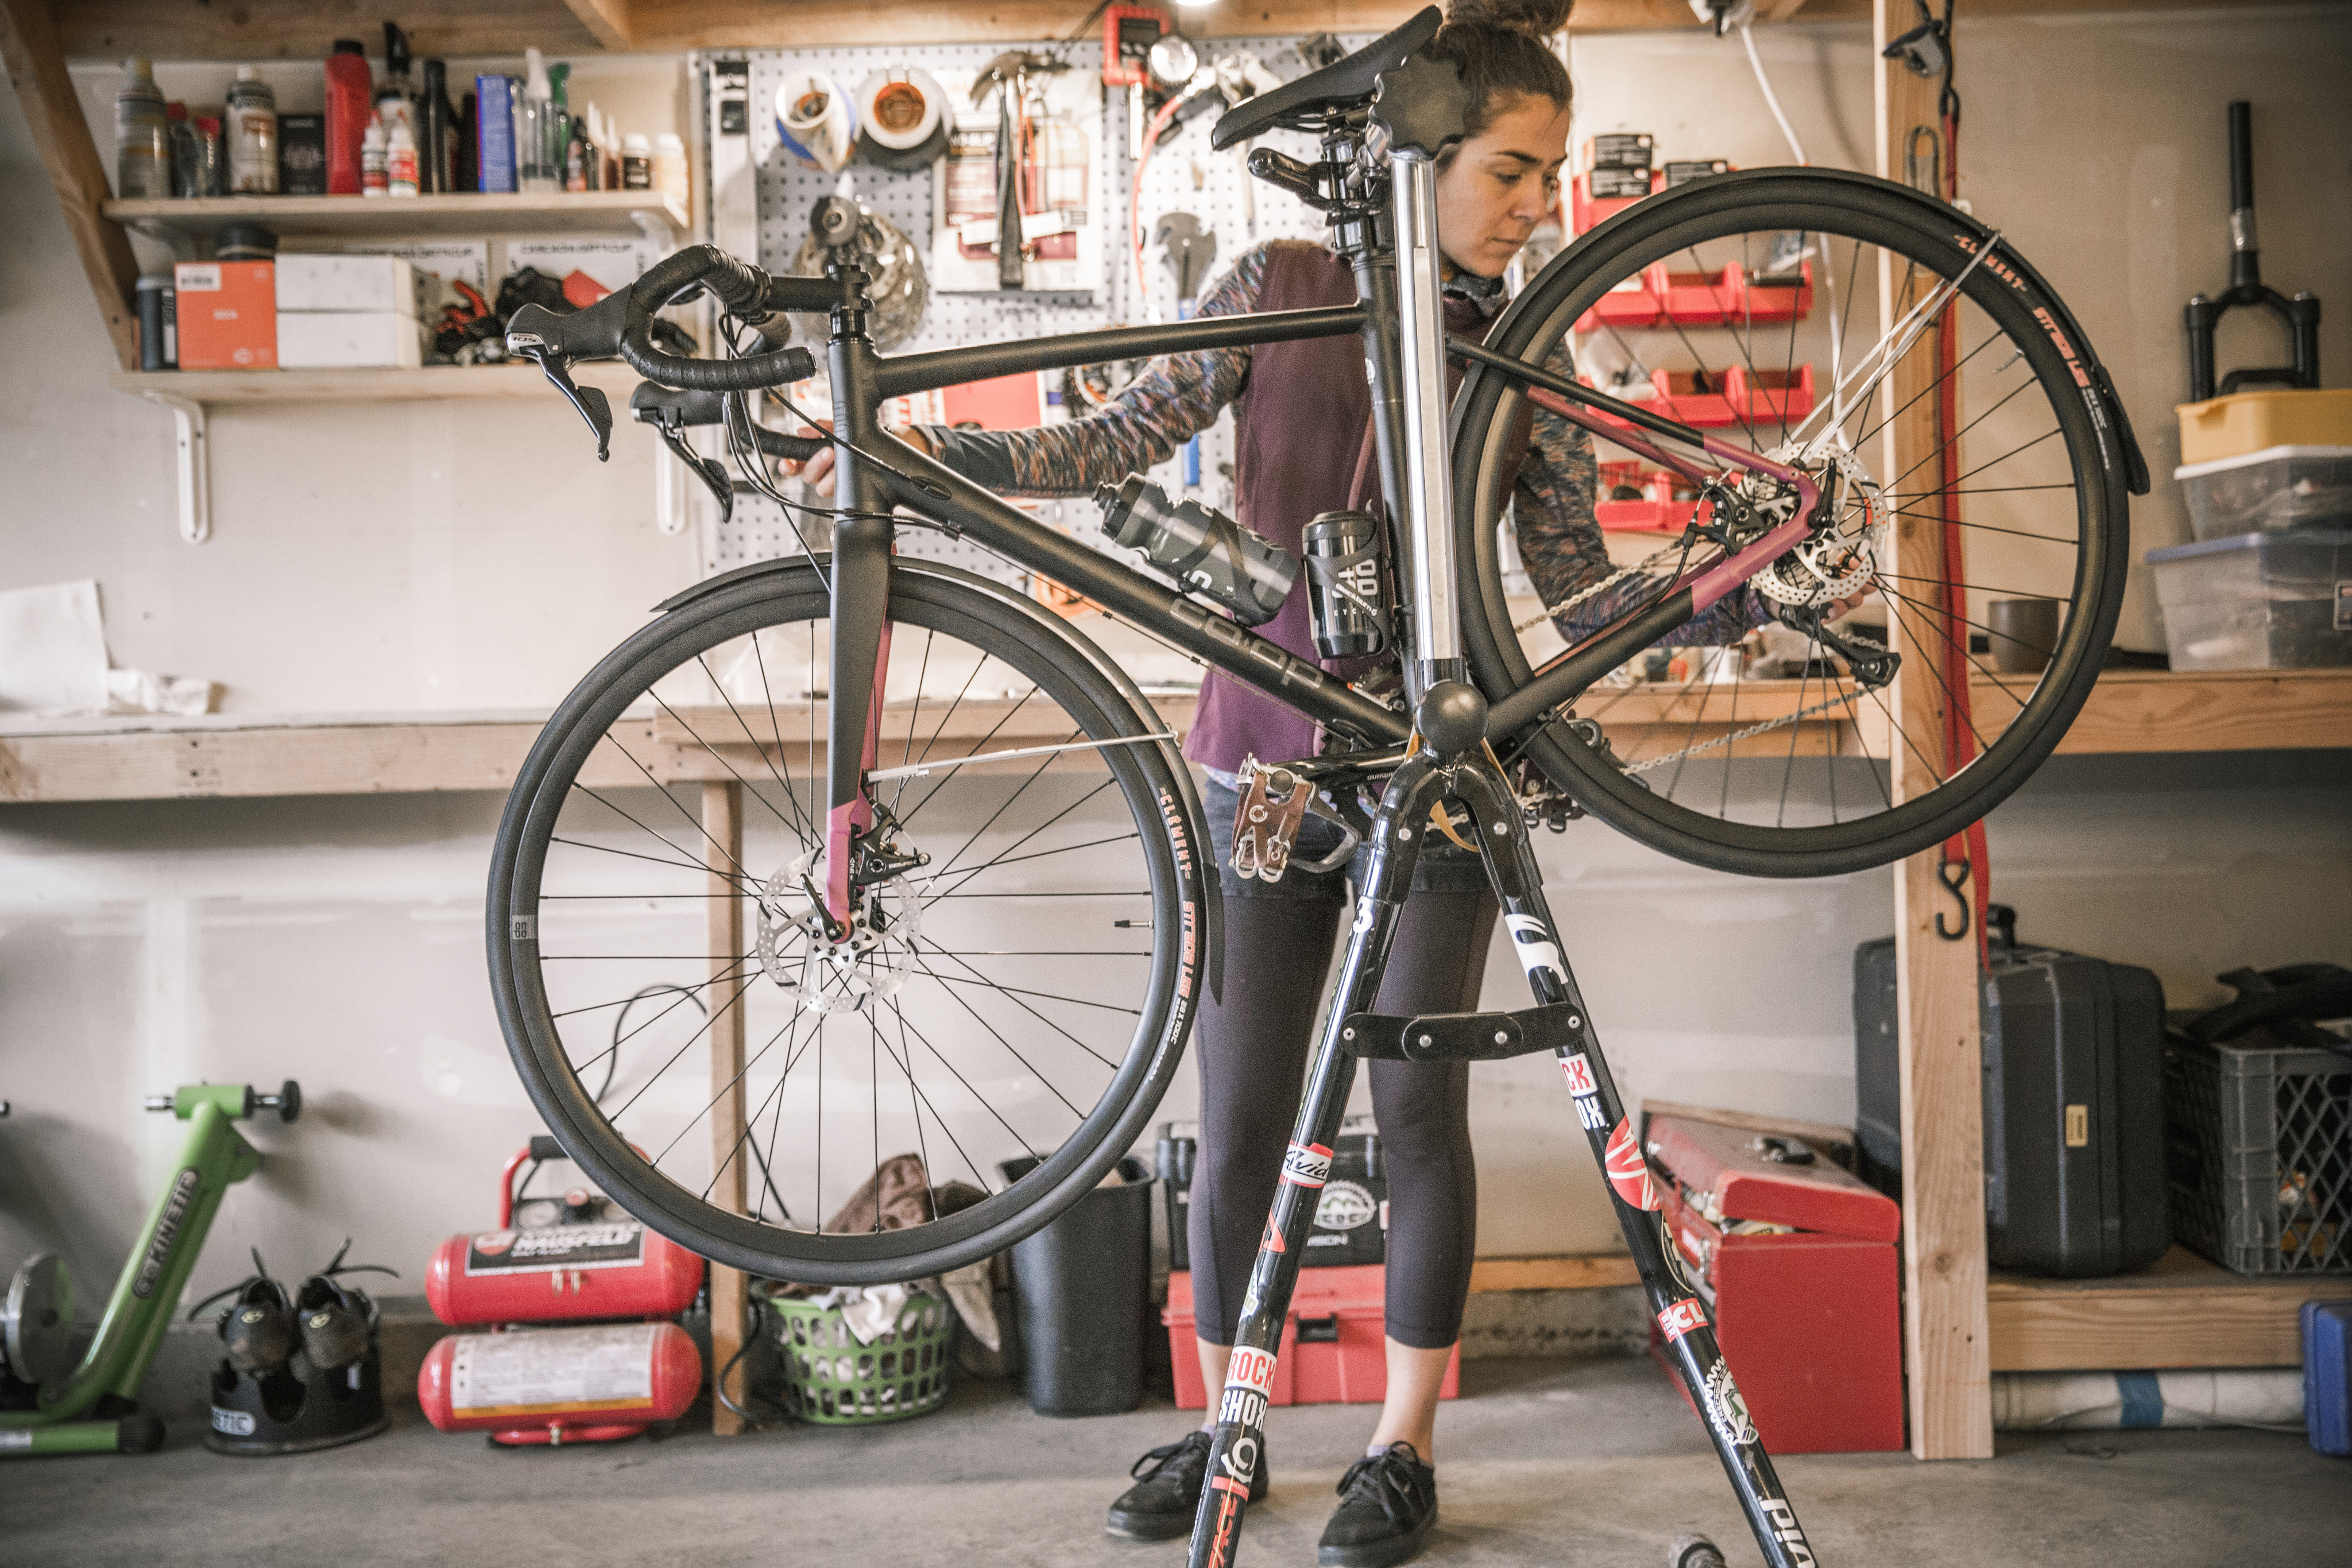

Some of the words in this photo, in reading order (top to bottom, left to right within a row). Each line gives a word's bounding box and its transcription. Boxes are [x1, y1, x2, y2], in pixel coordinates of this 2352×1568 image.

[1957, 235, 2022, 289] CLMENT
[1661, 1313, 1677, 1338] BAR
[1227, 1352, 1276, 1392] ROCK
[1218, 1389, 1268, 1433] SHOX
